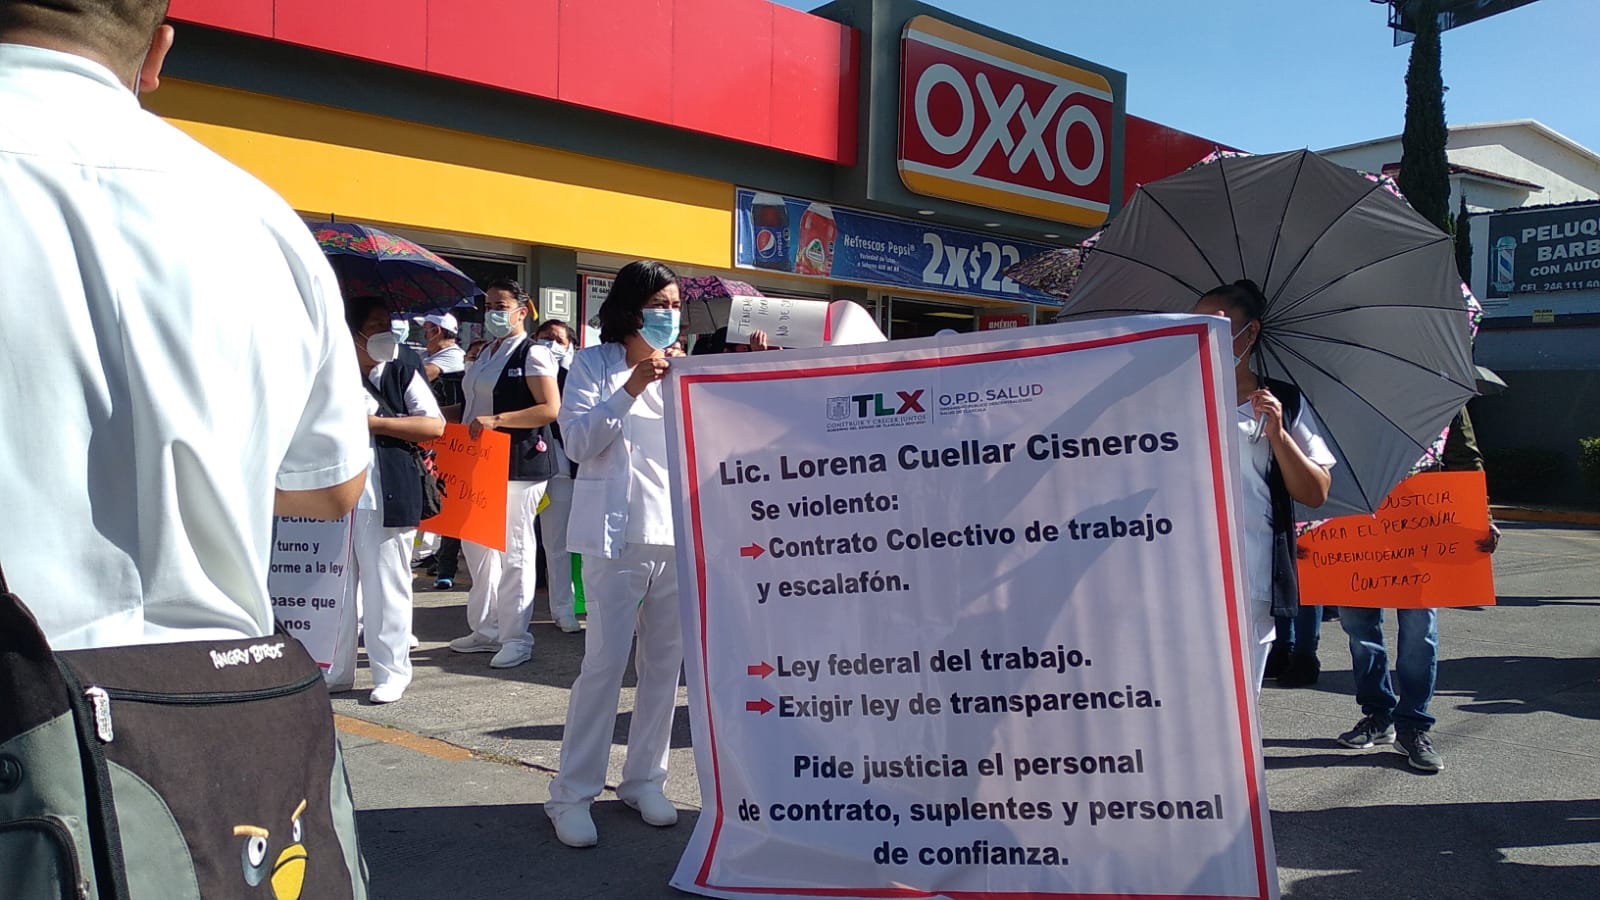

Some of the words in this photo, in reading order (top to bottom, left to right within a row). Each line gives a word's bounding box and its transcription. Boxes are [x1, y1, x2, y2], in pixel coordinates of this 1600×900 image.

[915, 63, 1104, 186] OXXO
[843, 234, 885, 253] Refrescos
[1522, 217, 1600, 244] PELUQ
[1530, 264, 1560, 277] CON
[551, 291, 565, 313] E
[852, 389, 926, 418] TLX
[939, 391, 984, 406] O.P.D.
[986, 384, 1044, 401] SALUD
[449, 438, 465, 453] NO
[720, 460, 770, 485] Lic.
[780, 453, 887, 480] Lorena
[898, 439, 1016, 470] Cuellar
[1026, 430, 1180, 461] Cisneros
[750, 499, 780, 521] Se
[787, 492, 899, 518] violento:
[1379, 490, 1454, 512] JUSTICIA
[769, 533, 878, 559] Contrato
[886, 524, 1016, 551] Colectivo
[1025, 520, 1059, 543] de
[1068, 513, 1173, 543] trabajo
[1310, 526, 1348, 543] PARA
[1357, 524, 1379, 539] EL
[1381, 511, 1462, 534] PERSONAL
[277, 540, 309, 552] turno
[312, 542, 320, 555] y
[1438, 541, 1460, 556] DE
[305, 564, 312, 574] a
[316, 561, 326, 574] la
[330, 561, 344, 577] ley
[1351, 571, 1432, 593] CONTRATO
[757, 582, 771, 604] y
[778, 570, 910, 597] escalafón.
[311, 597, 336, 611] que
[284, 619, 311, 630] nos
[209, 648, 249, 669] ANGRY
[249, 642, 285, 663] BIRDS
[777, 655, 820, 682] Ley
[827, 650, 921, 677] federal
[930, 648, 971, 673] del
[980, 645, 1092, 674] trabajo.
[779, 695, 853, 722] Exigir
[861, 693, 900, 722] ley
[908, 692, 942, 716] de
[950, 685, 1162, 718] transparencia.
[794, 755, 854, 779] Pide
[862, 753, 968, 785] justicia
[978, 752, 1004, 777] el
[1014, 749, 1144, 782] personal
[738, 798, 760, 822] de
[769, 799, 900, 827] contrato,
[910, 796, 1053, 827] suplentes
[1062, 801, 1079, 826] y
[1089, 794, 1224, 826] personal
[873, 841, 908, 866] de
[918, 840, 1069, 866] confianza.
